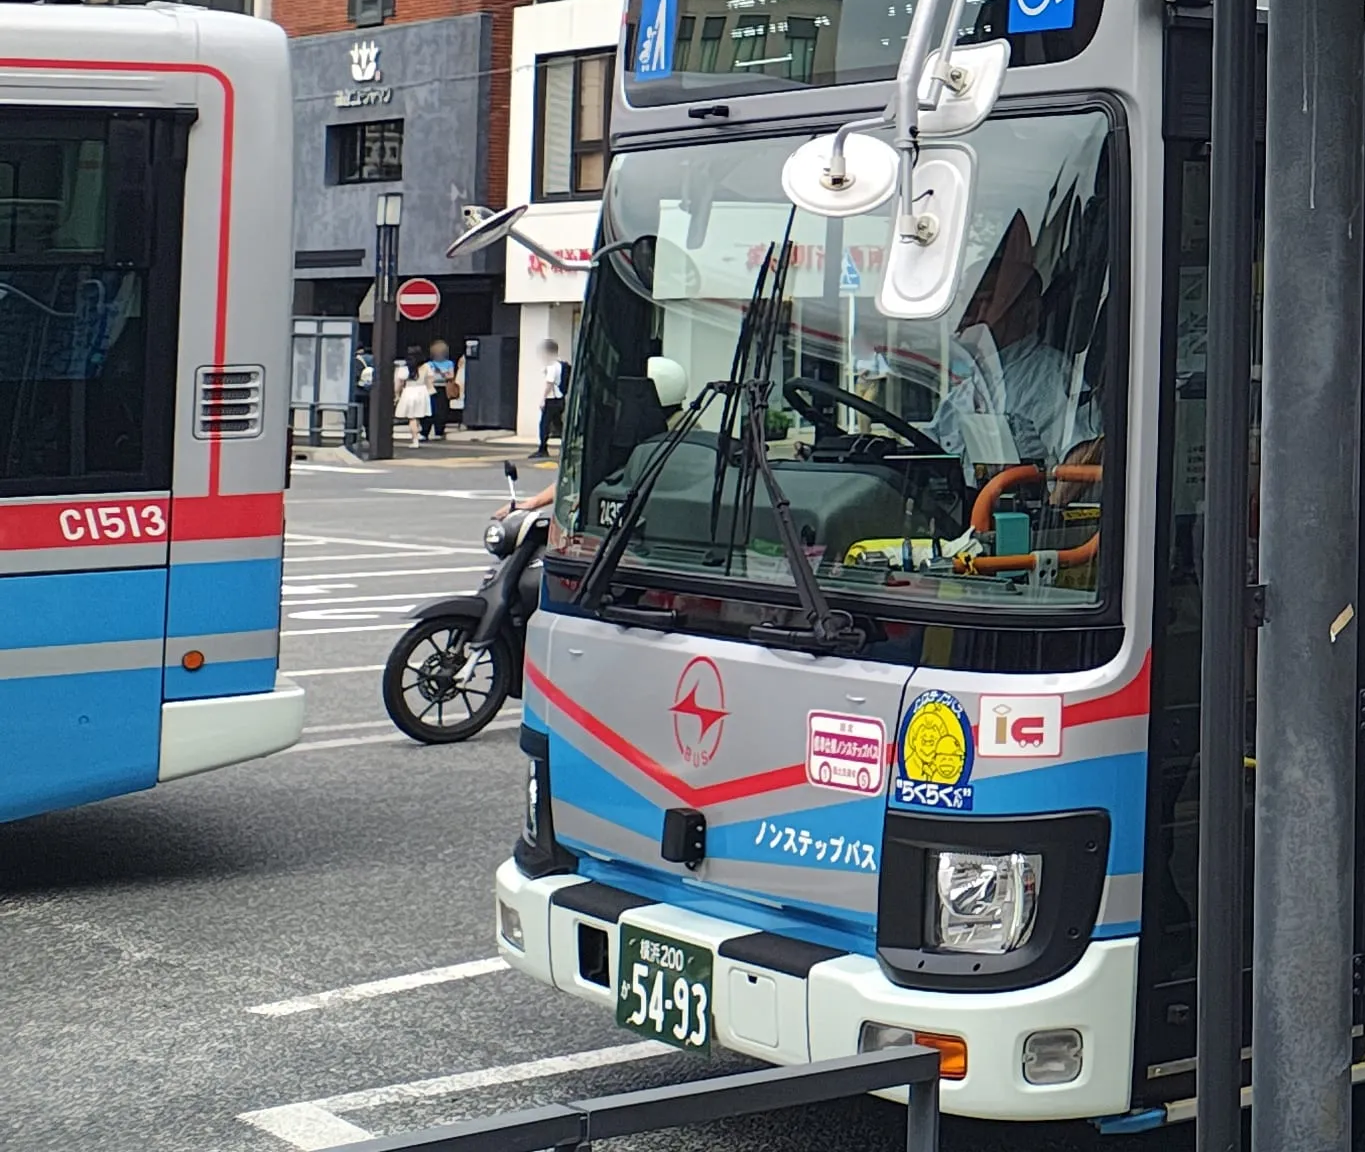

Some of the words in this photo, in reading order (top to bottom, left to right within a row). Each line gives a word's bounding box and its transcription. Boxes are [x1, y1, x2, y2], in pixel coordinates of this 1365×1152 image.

[59, 505, 167, 541] C1513
[683, 745, 709, 769] BUS
[755, 821, 877, 871] ノンステップバス
